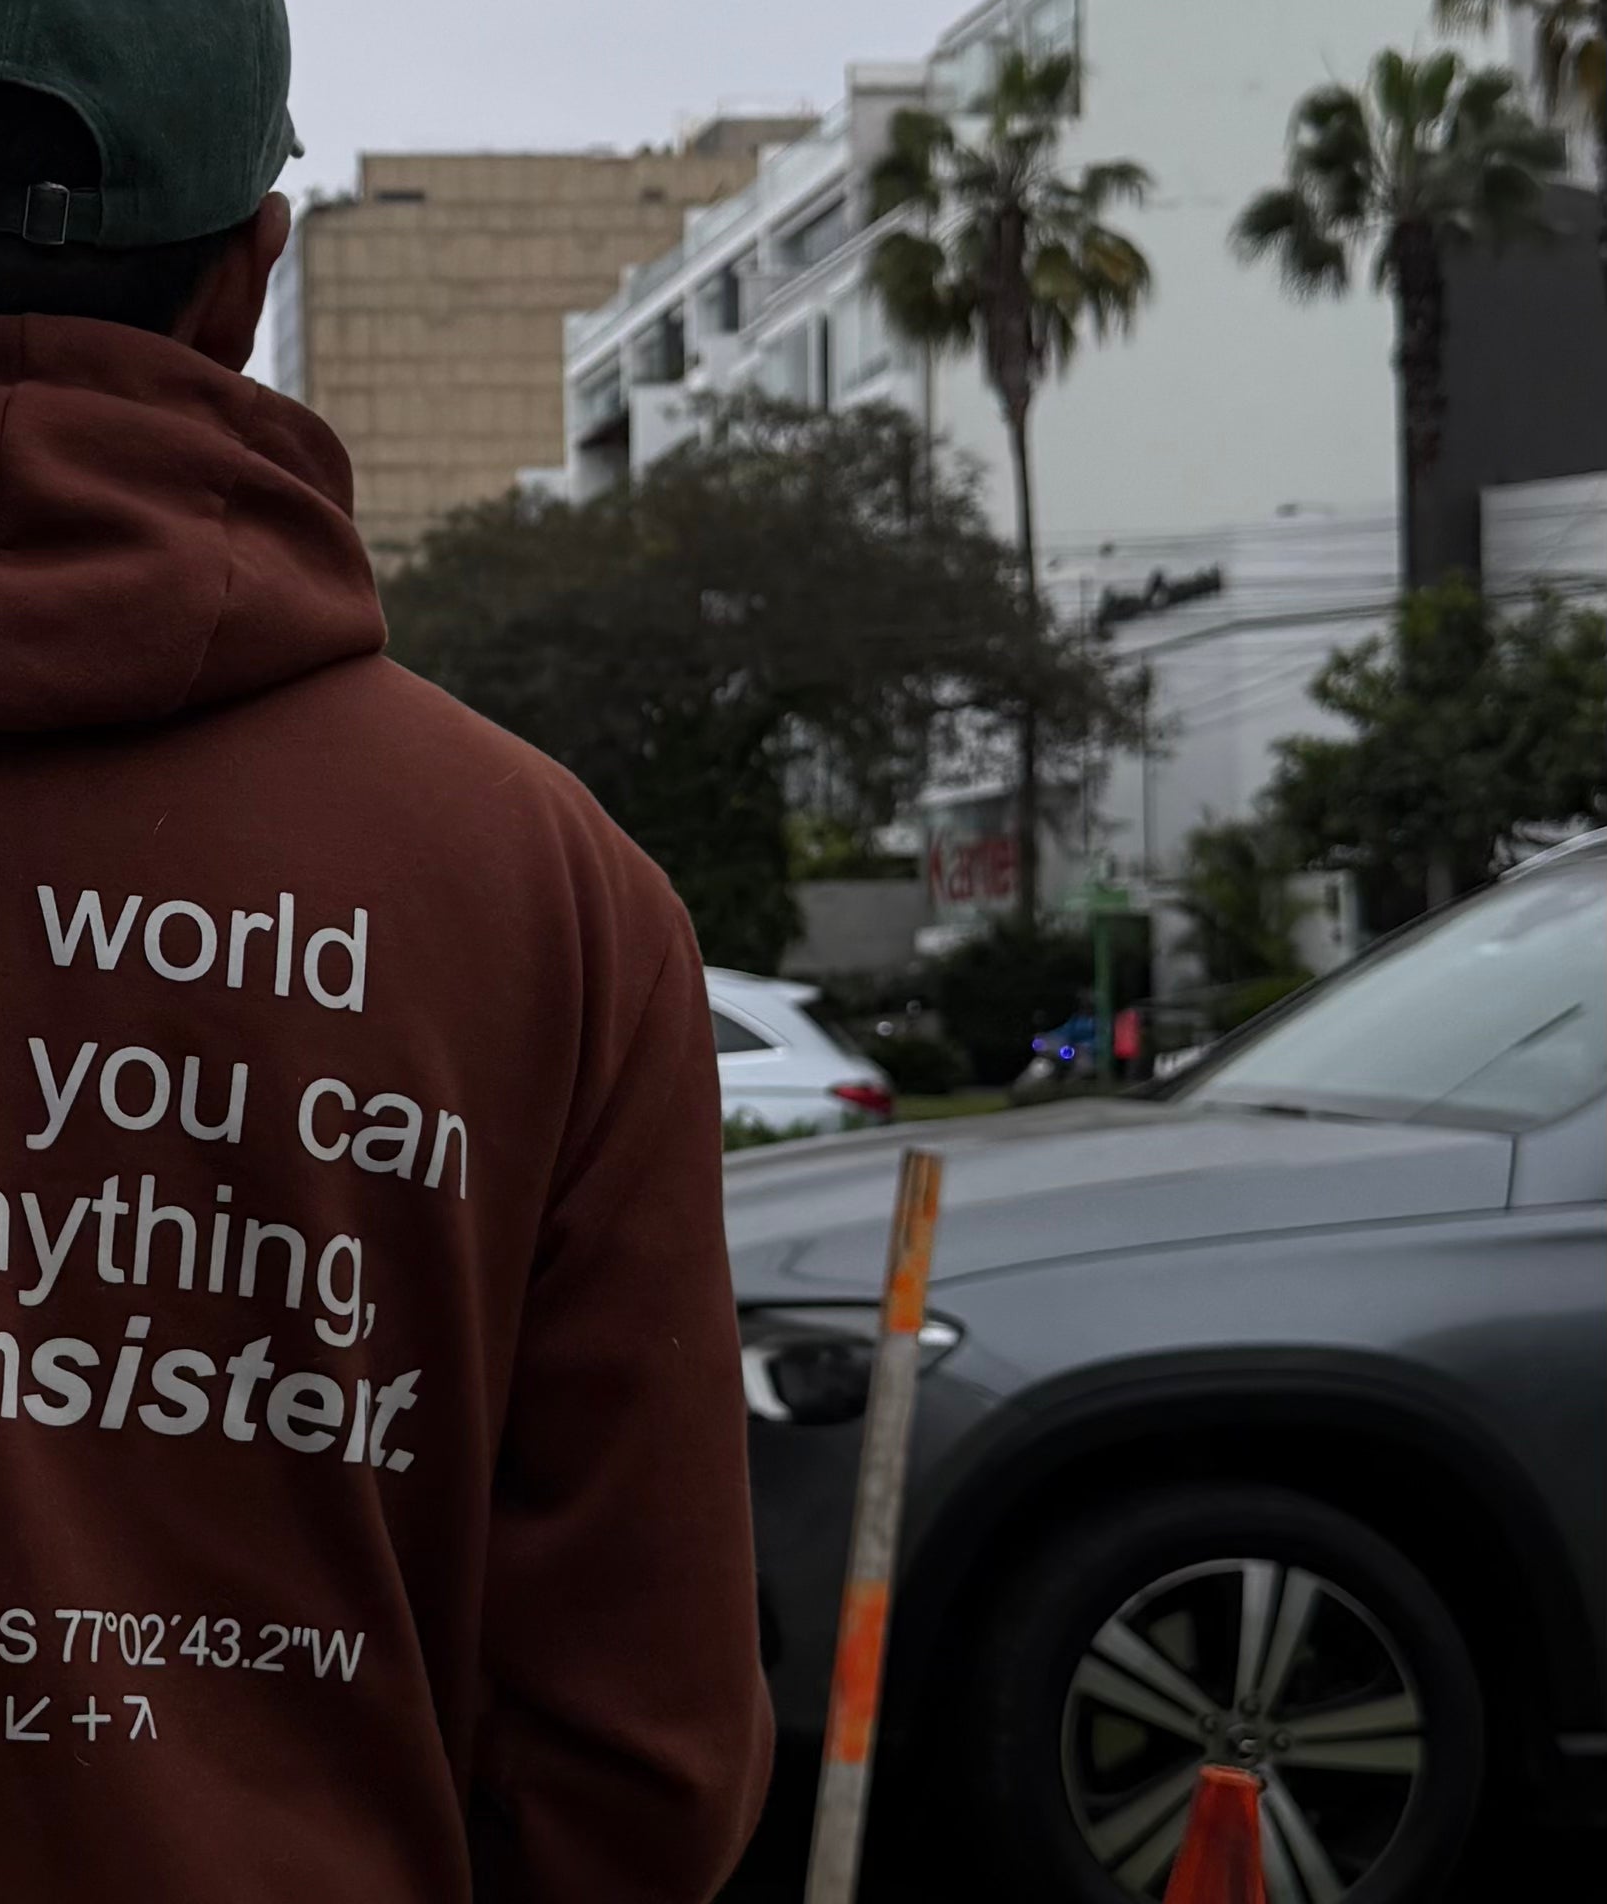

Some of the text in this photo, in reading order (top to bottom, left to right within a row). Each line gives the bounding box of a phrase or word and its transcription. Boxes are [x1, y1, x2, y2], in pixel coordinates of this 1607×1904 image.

[36, 884, 369, 1013] world
[26, 1037, 249, 1150] you
[298, 1077, 468, 1200] can
